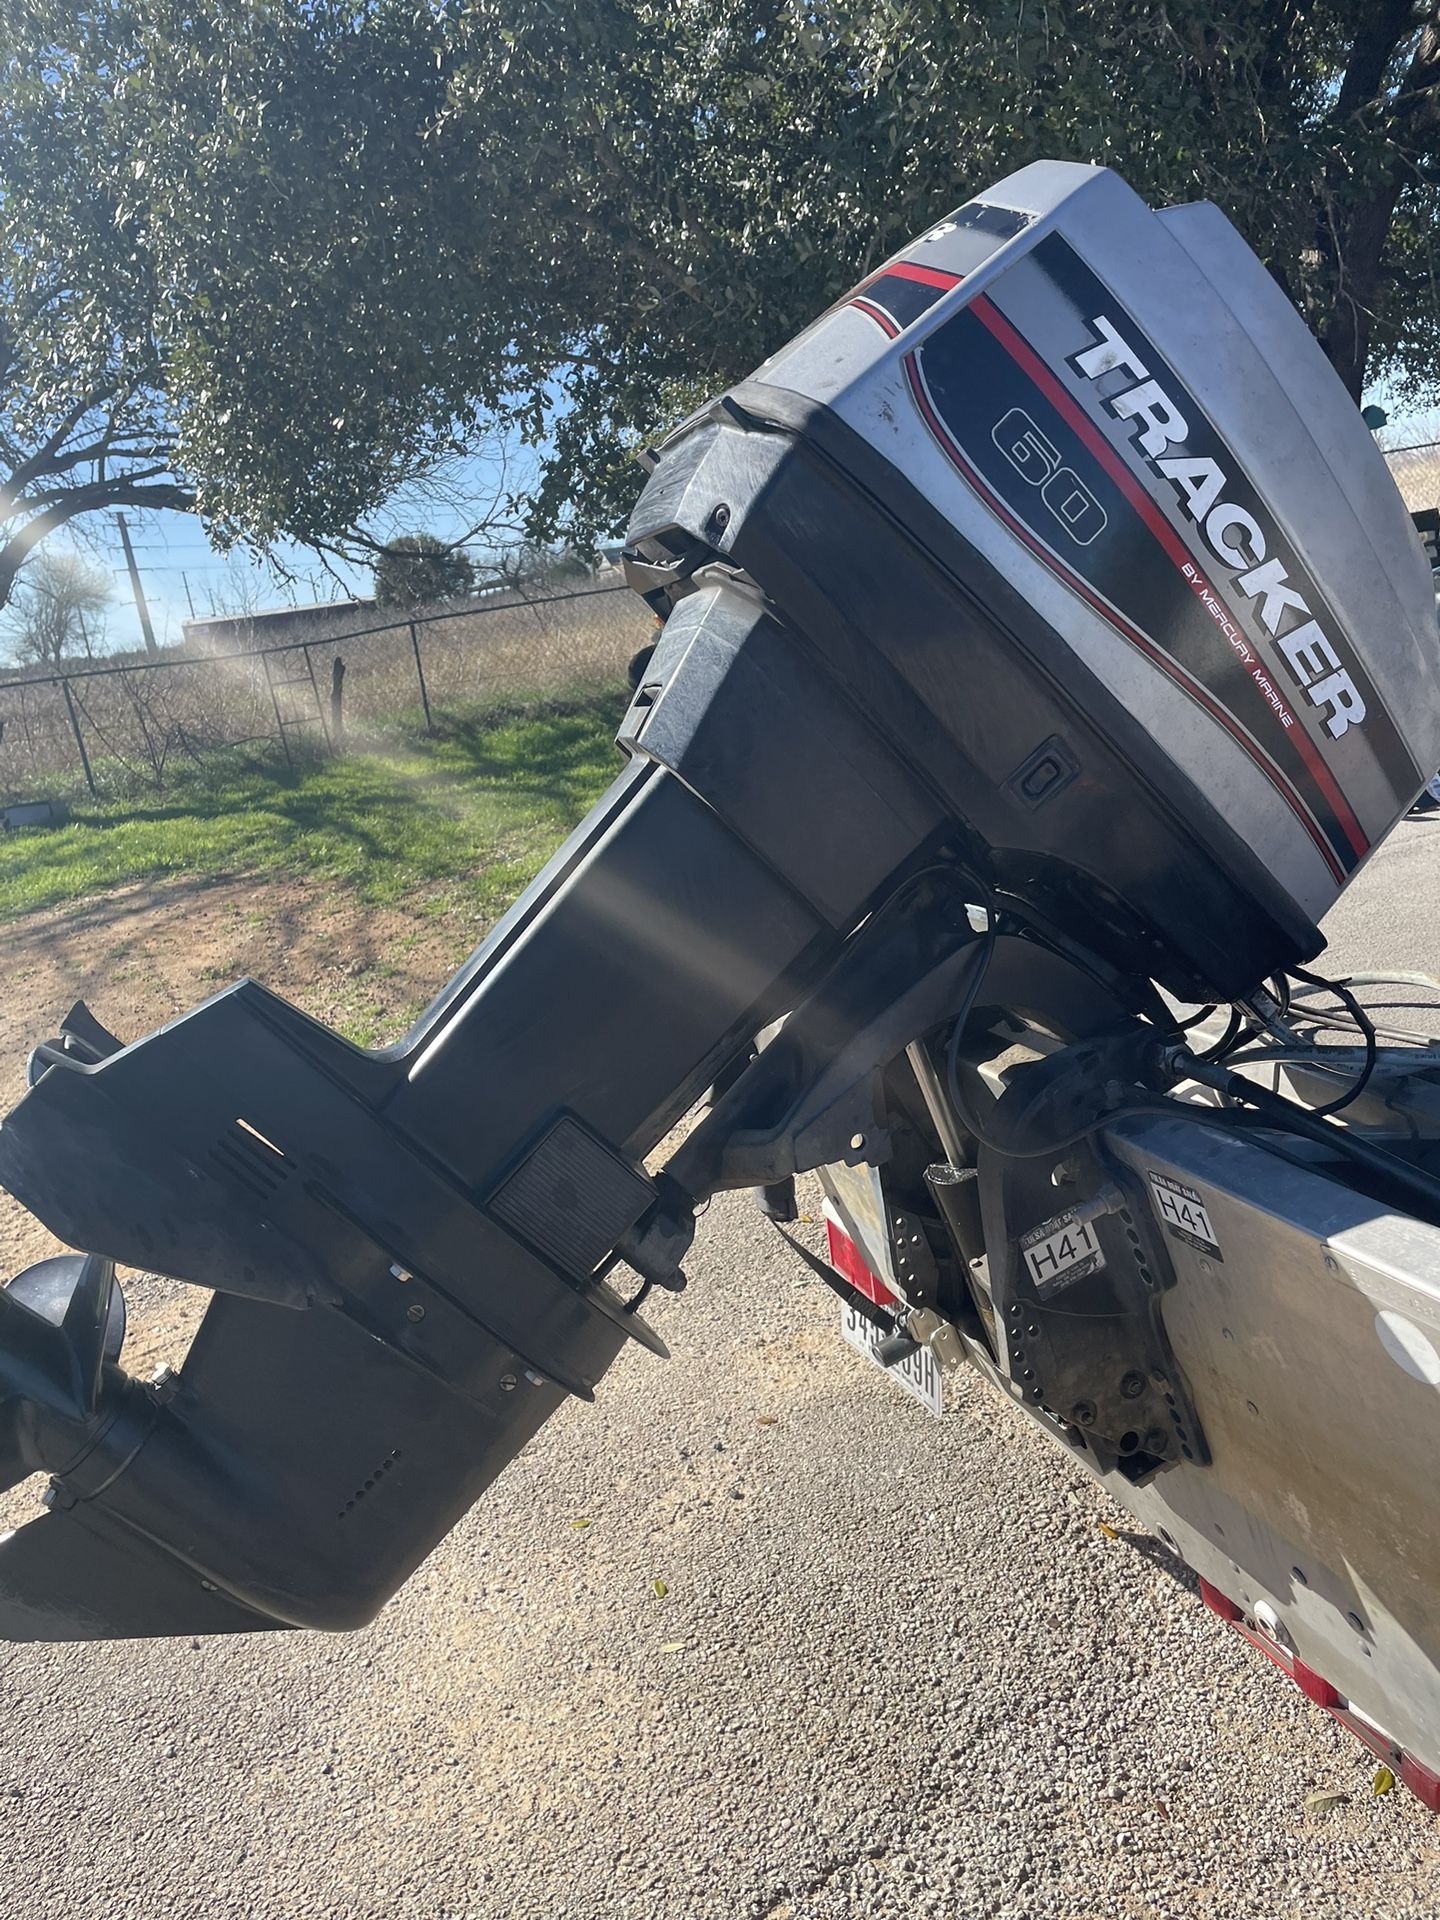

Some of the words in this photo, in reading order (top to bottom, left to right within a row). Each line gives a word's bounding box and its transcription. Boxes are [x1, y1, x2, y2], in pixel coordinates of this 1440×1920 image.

[991, 407, 1108, 546] 60
[1074, 314, 1367, 741] TRACKER
[1181, 562, 1203, 585] BY
[1199, 588, 1256, 665] MERCURY
[1252, 668, 1294, 729] MARINE
[1030, 1225, 1093, 1279] H41
[1156, 1188, 1212, 1239] H41
